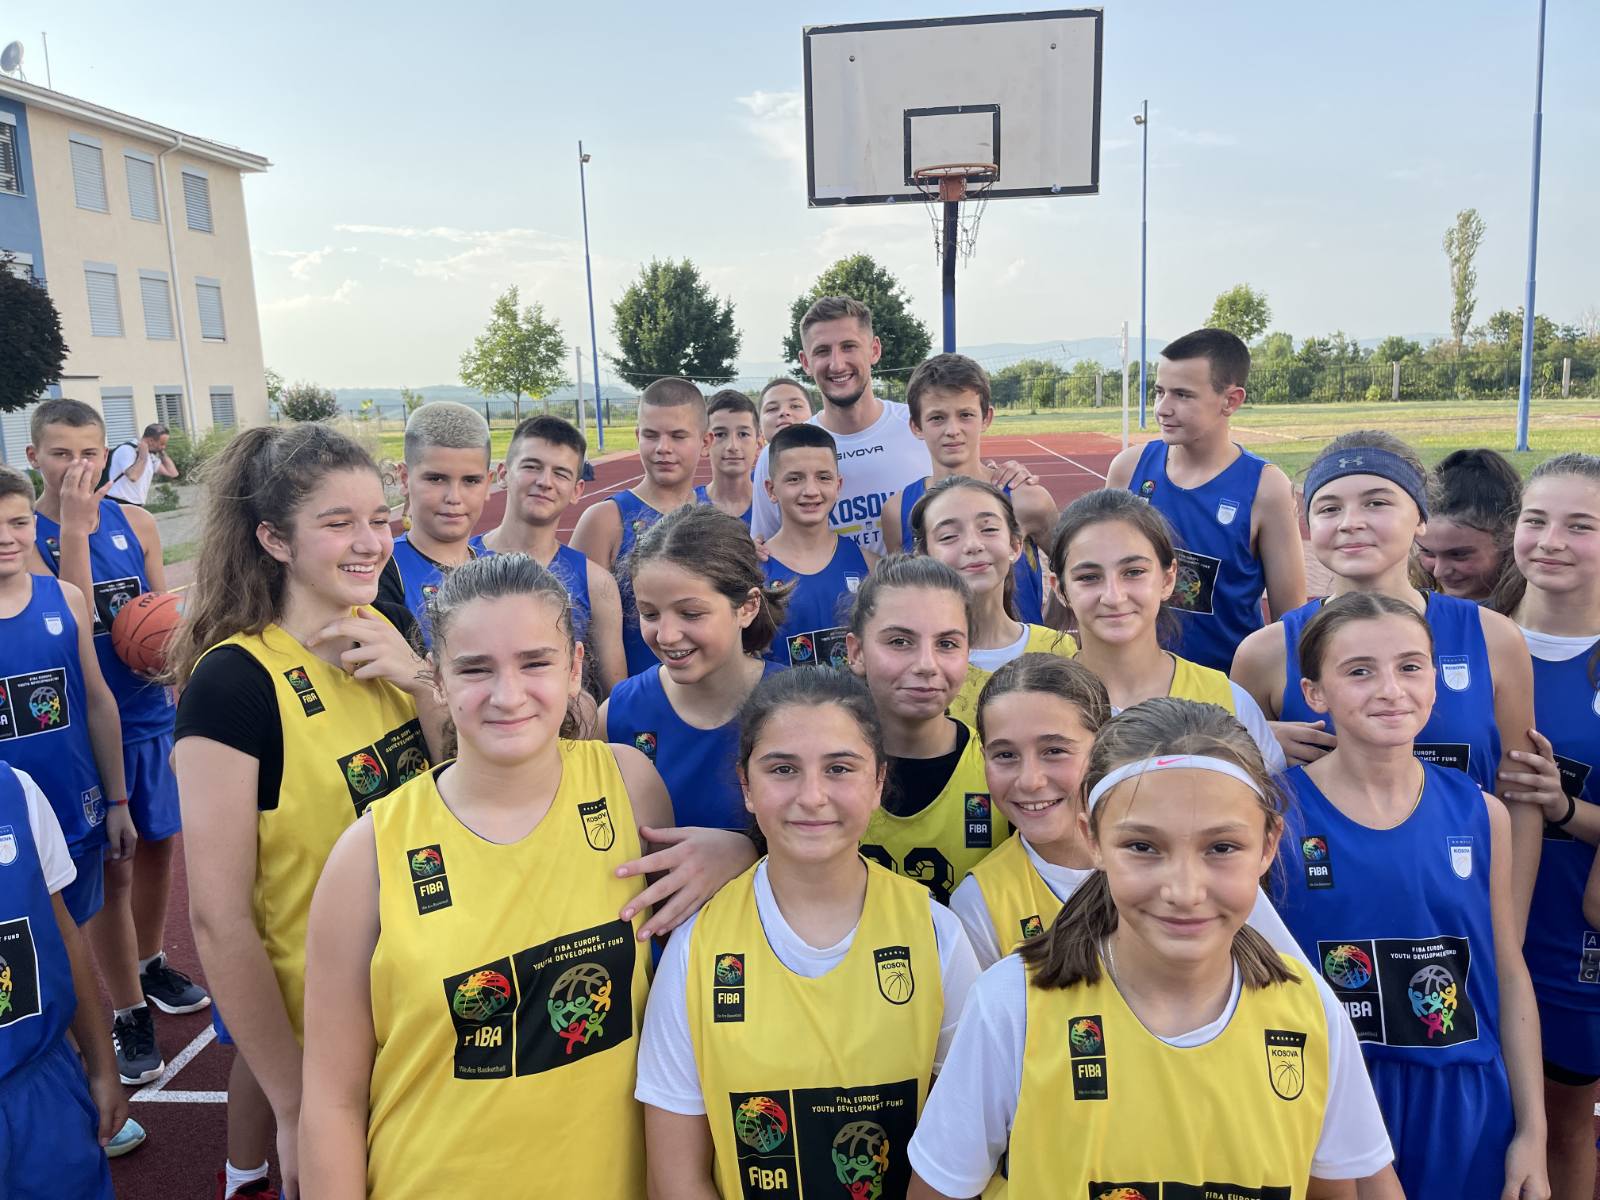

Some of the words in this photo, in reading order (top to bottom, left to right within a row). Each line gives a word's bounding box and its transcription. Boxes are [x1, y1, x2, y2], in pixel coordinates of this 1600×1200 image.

[836, 445, 884, 460] GIVOVA
[828, 492, 895, 525] KOSO
[969, 823, 988, 833] FIBA
[1308, 866, 1328, 876] FIBA
[420, 880, 444, 897] FIBA
[553, 944, 572, 954] FIBA
[574, 935, 600, 948] EUROPE
[555, 942, 606, 962] DEVELOPMENT
[608, 936, 624, 947] FUND
[1390, 952, 1411, 960] YOUTH
[718, 992, 740, 1005] FIBA
[1341, 1001, 1373, 1018] IBA
[1271, 1049, 1299, 1058] KOSOVA
[1078, 1063, 1102, 1079] FIBA
[812, 1105, 835, 1113] YOUTH
[886, 1099, 904, 1107] FUND
[749, 1166, 788, 1190] FIBA
